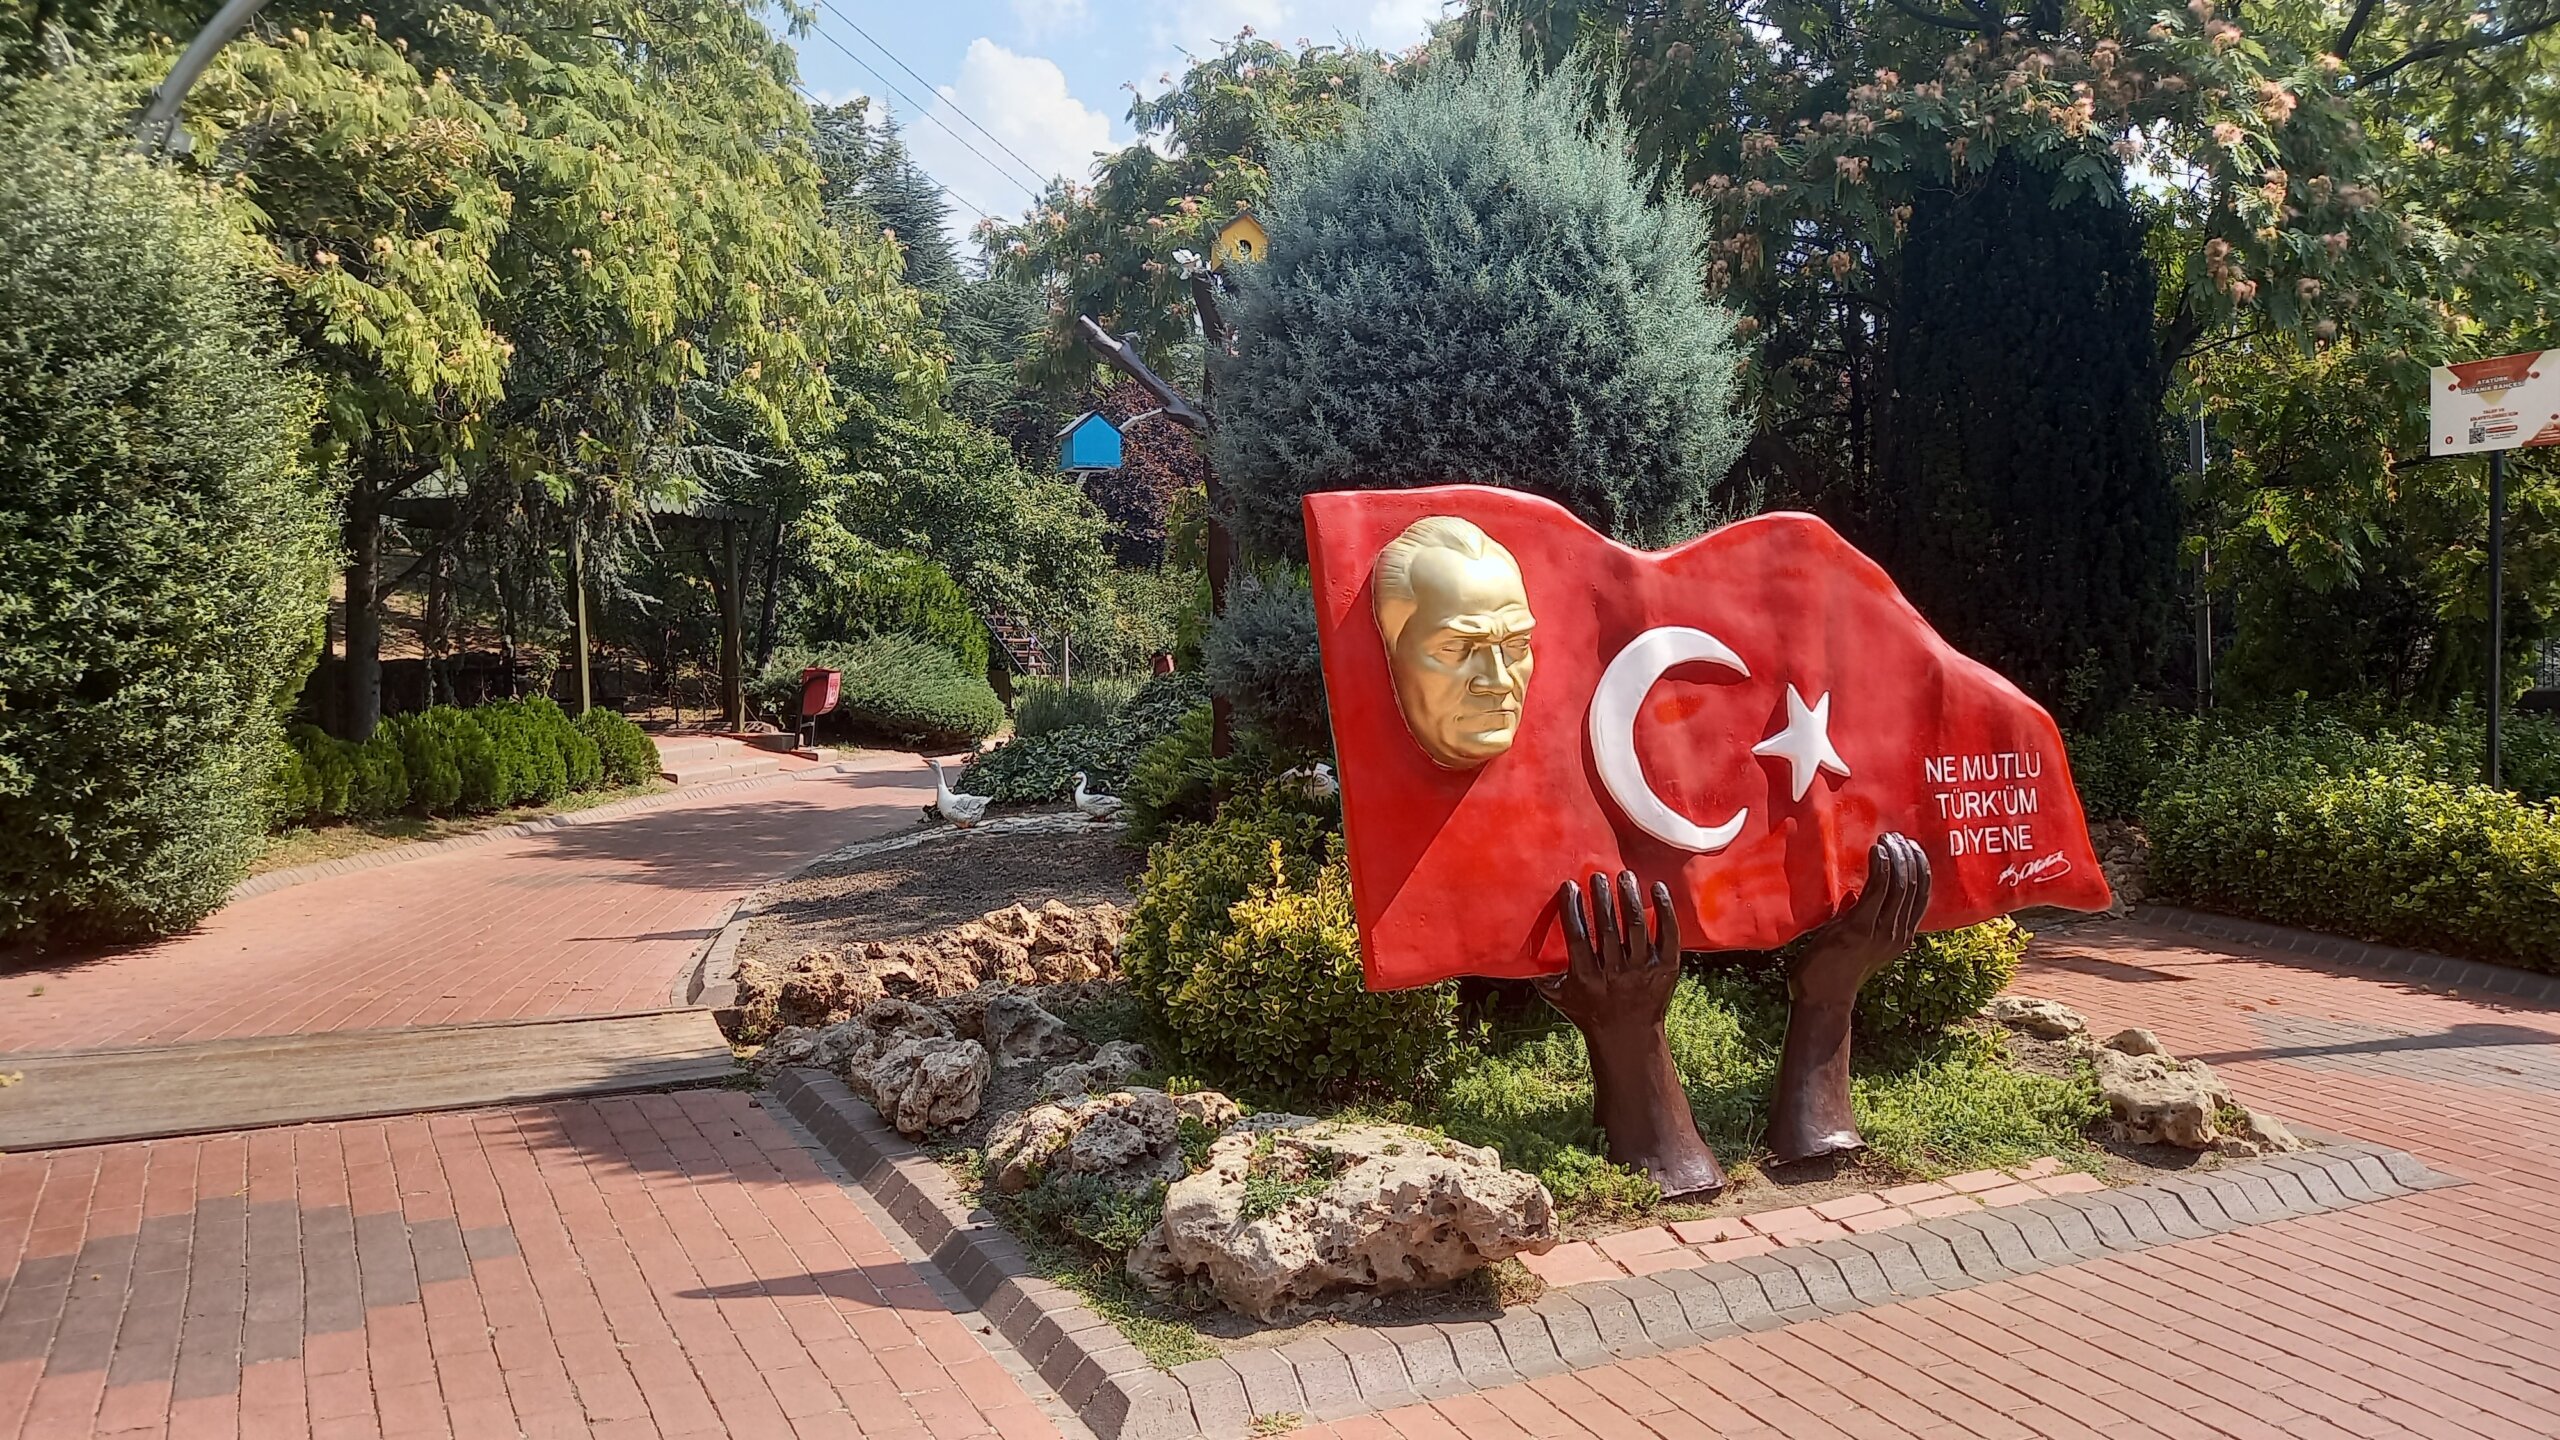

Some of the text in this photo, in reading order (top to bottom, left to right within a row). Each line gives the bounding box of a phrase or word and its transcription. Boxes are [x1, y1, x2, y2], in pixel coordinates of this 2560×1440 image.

[2477, 375, 2509, 385] ATATÜRK
[1925, 752, 2041, 783] NE MUTLU
[1935, 785, 2038, 820] TÜRK'ÜM
[1949, 824, 2033, 857] DİYENE
